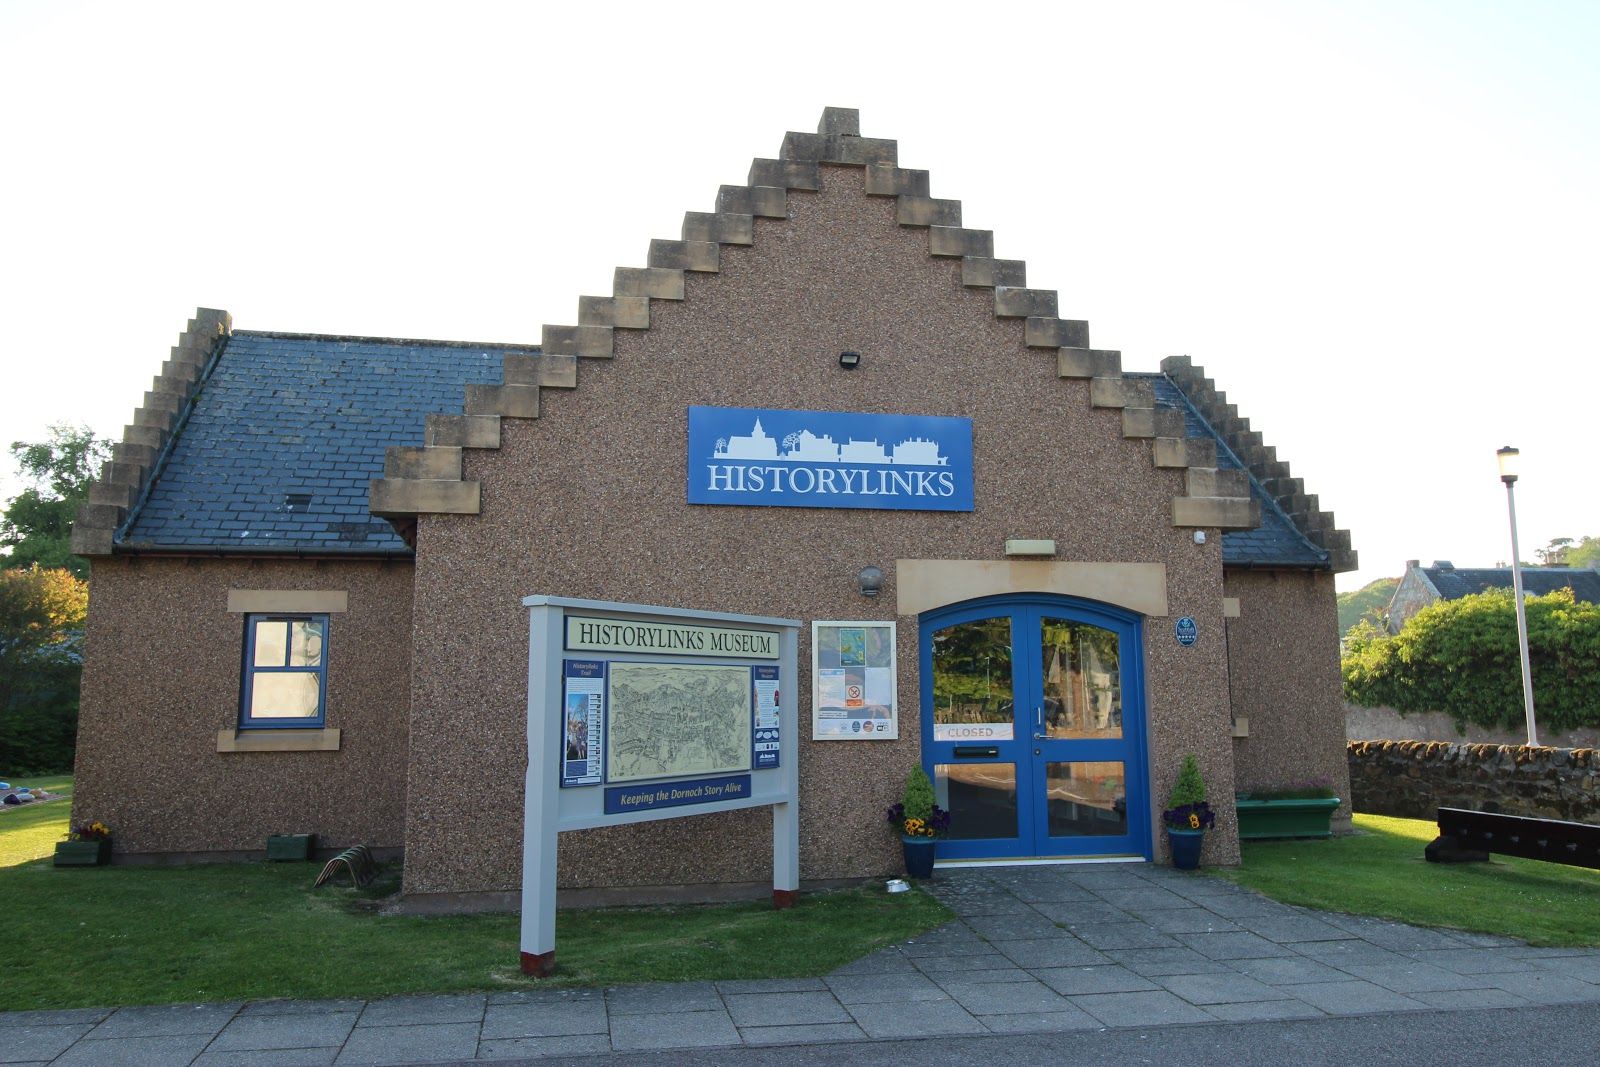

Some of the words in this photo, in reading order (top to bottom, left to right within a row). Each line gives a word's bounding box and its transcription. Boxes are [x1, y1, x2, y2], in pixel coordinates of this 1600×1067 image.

[707, 465, 954, 497] HISTORYLINKS
[579, 623, 704, 650] HISTORYLINKS
[710, 632, 771, 653] MUSEUM
[948, 728, 993, 737] CLOSED
[620, 792, 654, 806] Keeping
[656, 790, 668, 801] the
[671, 788, 702, 799] Dornoch
[704, 785, 723, 796] Story
[725, 783, 742, 792] Alive
